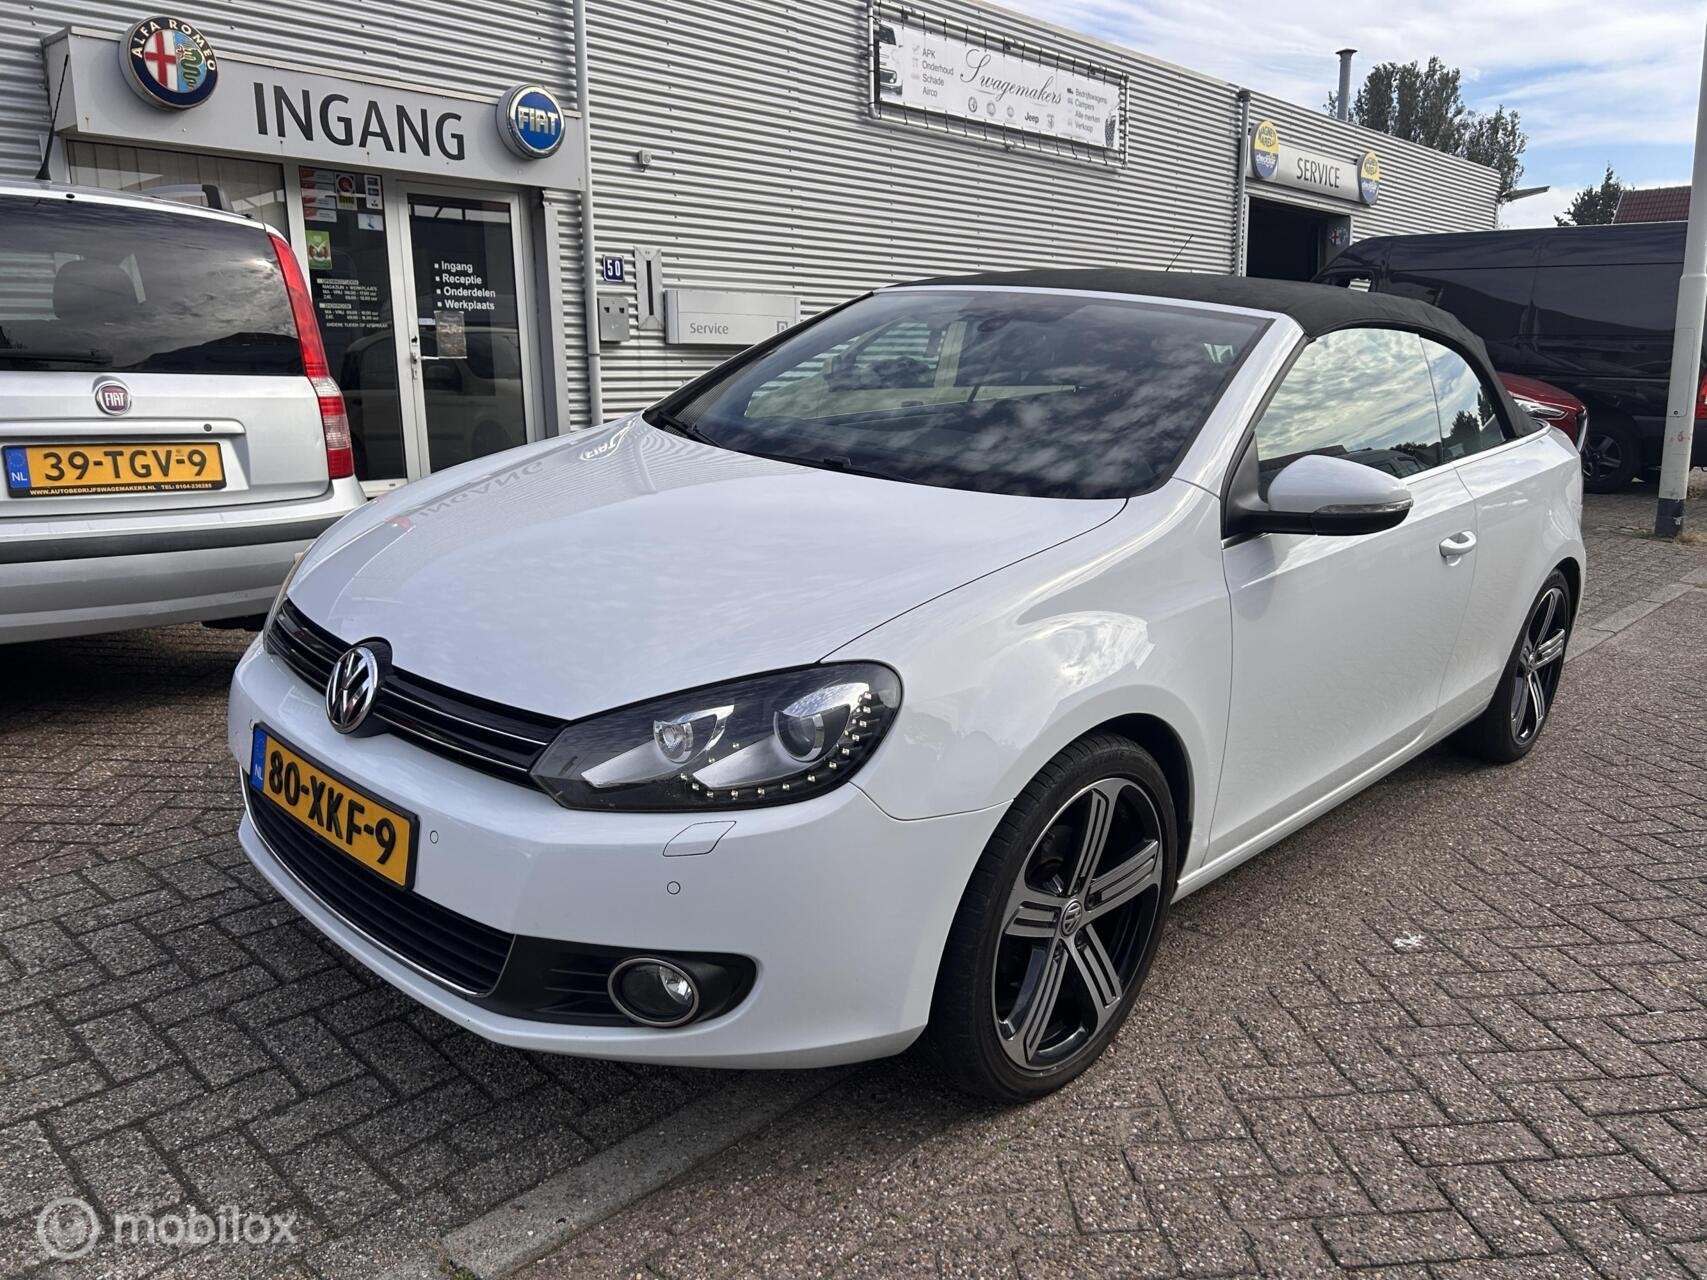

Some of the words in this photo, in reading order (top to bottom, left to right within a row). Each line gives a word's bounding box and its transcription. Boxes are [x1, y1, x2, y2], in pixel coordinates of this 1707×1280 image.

[131, 21, 161, 59] ALFA
[168, 19, 217, 71] ROMEO
[922, 48, 936, 59] APK
[922, 60, 955, 76] Onderhoud
[922, 73, 945, 87] Schade
[960, 48, 1062, 105] Swagemakers
[922, 86, 938, 97] Airco
[253, 82, 466, 161] INGANG
[517, 105, 559, 136] FIAT
[1024, 111, 1040, 124] Jeep
[1296, 157, 1340, 188] SERVICE
[441, 260, 473, 274] Ingang
[606, 259, 621, 277] 50
[442, 273, 482, 286] Receptie
[443, 286, 496, 298] Onderdelen
[444, 299, 495, 312] Werkplaats
[689, 322, 729, 335] Service
[104, 391, 126, 407] FIAT
[11, 472, 28, 482] NL
[43, 449, 207, 482] 39-TGV-9
[253, 764, 264, 782] NL
[268, 751, 397, 865] 80-XKF-9
